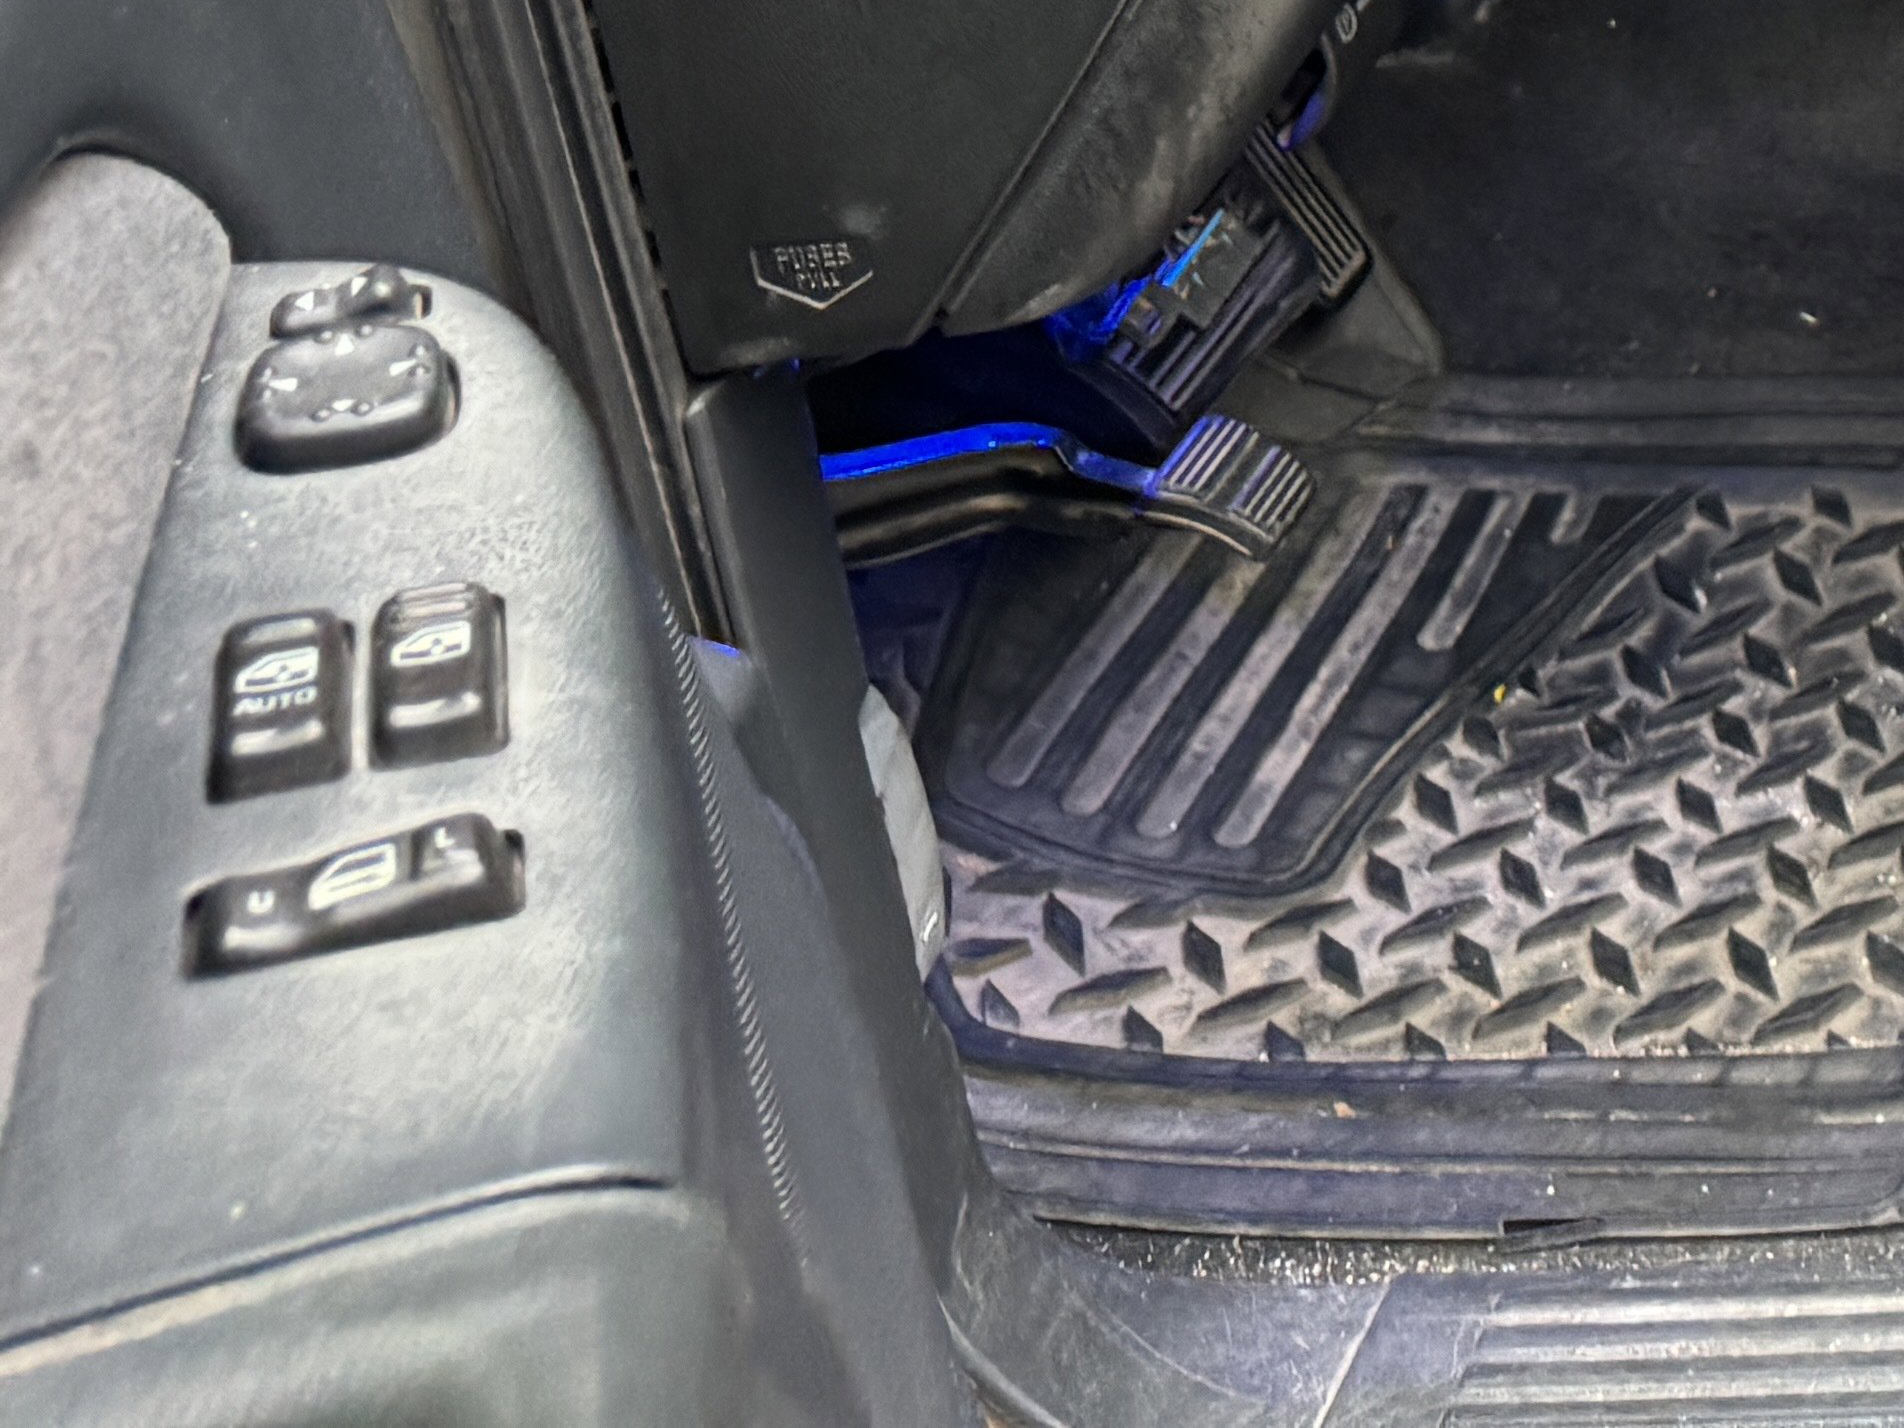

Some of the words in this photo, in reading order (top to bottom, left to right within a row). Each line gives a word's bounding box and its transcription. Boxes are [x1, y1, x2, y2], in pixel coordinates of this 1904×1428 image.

[232, 685, 318, 716] AUTO
[434, 826, 455, 849] L
[246, 889, 276, 915] U
